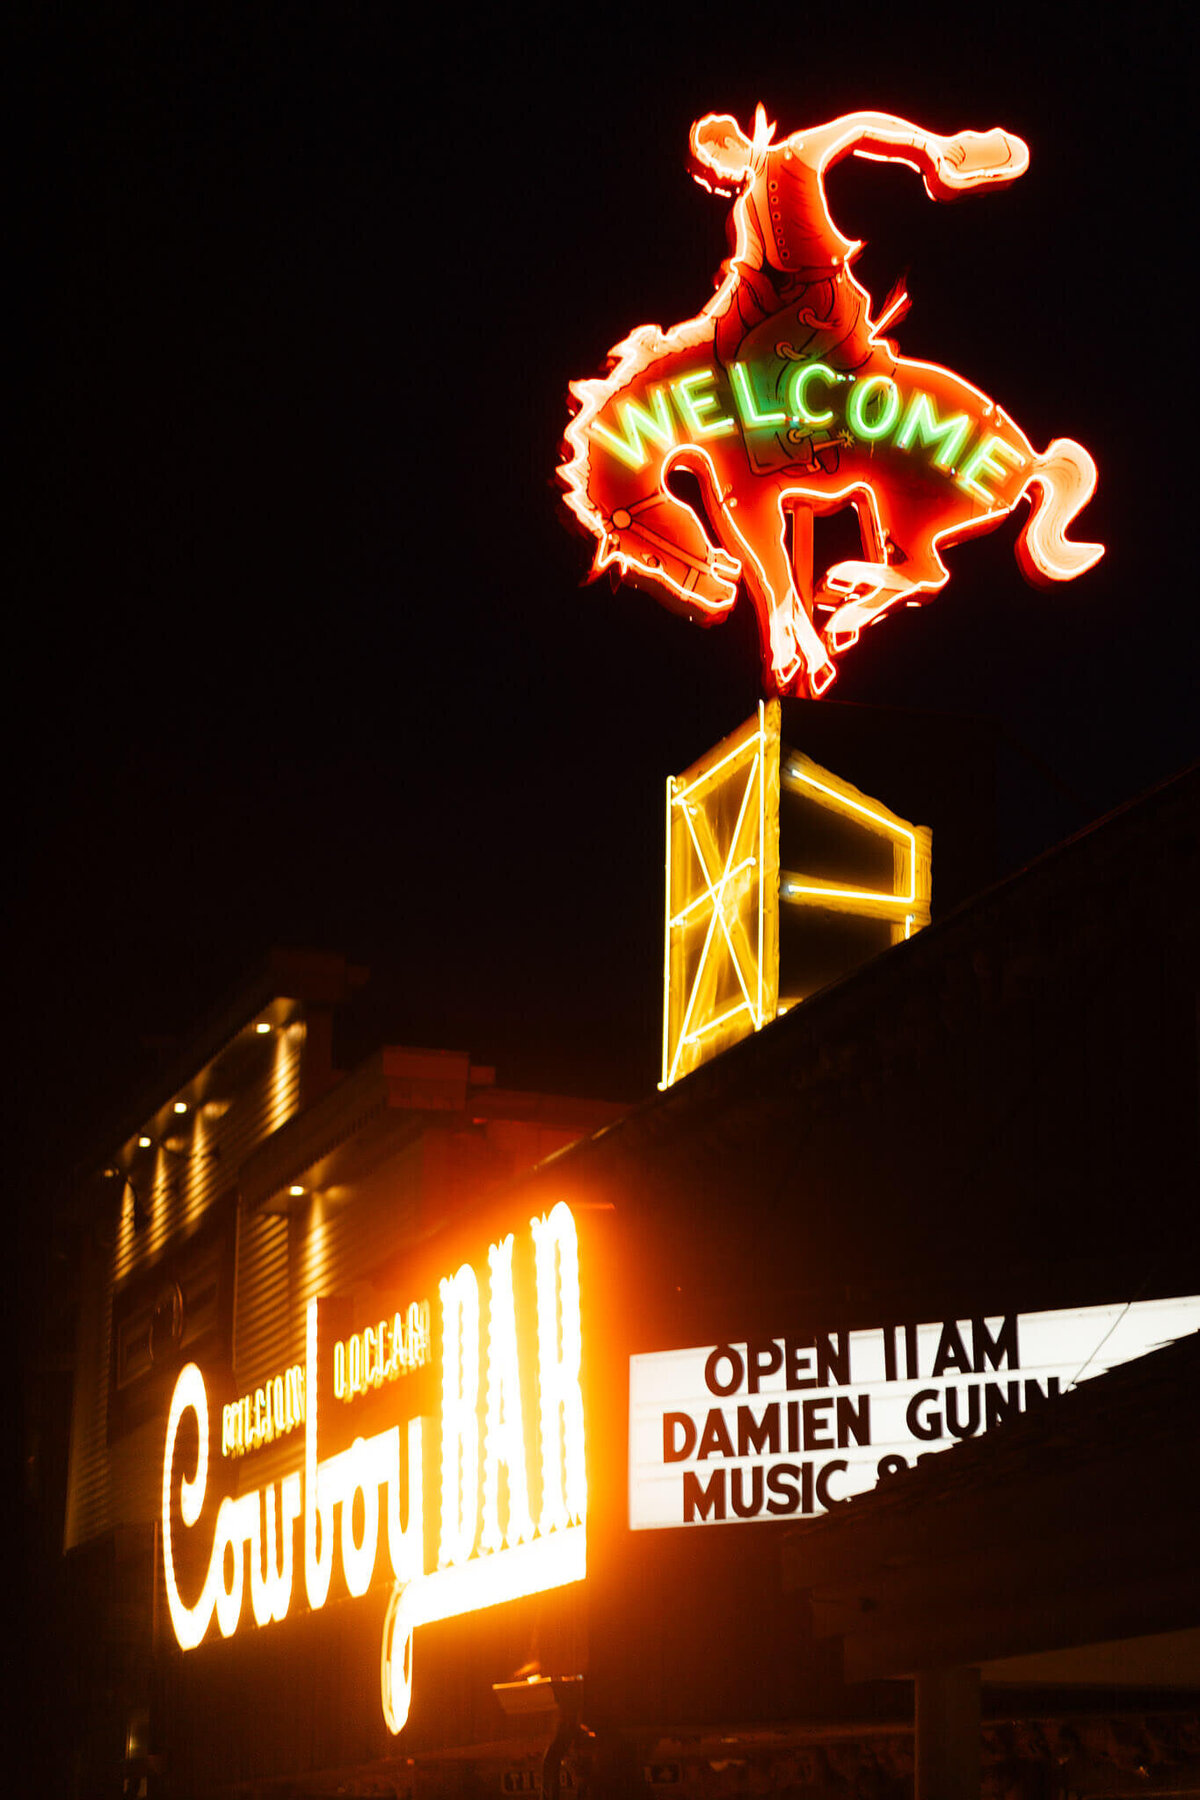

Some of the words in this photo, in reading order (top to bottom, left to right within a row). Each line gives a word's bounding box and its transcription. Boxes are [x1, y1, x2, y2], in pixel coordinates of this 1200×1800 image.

[589, 361, 1031, 509] WELCOME
[437, 1201, 586, 1568] BAR
[704, 1333, 851, 1397] OPEN
[663, 1394, 871, 1463] DAMIEN
[683, 1459, 850, 1524] MUSIC
